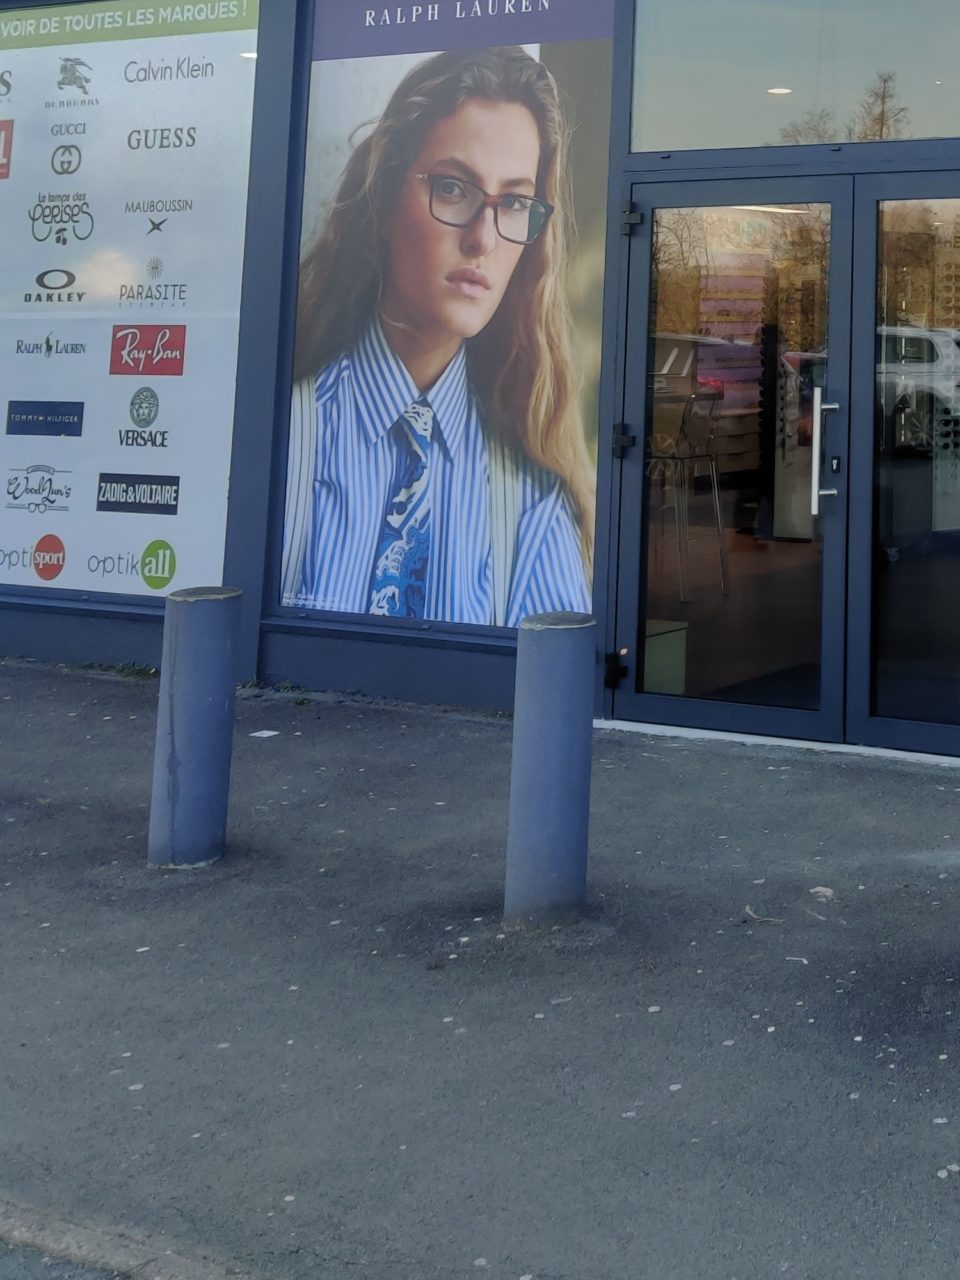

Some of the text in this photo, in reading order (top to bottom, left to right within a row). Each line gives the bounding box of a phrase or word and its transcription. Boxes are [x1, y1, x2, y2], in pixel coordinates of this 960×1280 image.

[1, 19, 36, 37] VOIR
[39, 17, 60, 34] DE
[63, 11, 123, 32] TOUTES
[127, 8, 155, 27] LES
[158, 1, 239, 24] MARQUES
[365, 4, 440, 26] RALPH
[124, 55, 214, 83] Calvin Klein
[50, 122, 87, 136] GUCCI
[127, 126, 197, 150] GUESS
[124, 199, 193, 213] MAUBOUSSIN
[24, 292, 86, 303] OAKLEY
[119, 284, 188, 301] PARASITE
[118, 429, 169, 448] VERSACE
[34, 551, 64, 568] sport
[87, 549, 171, 578] optik all
